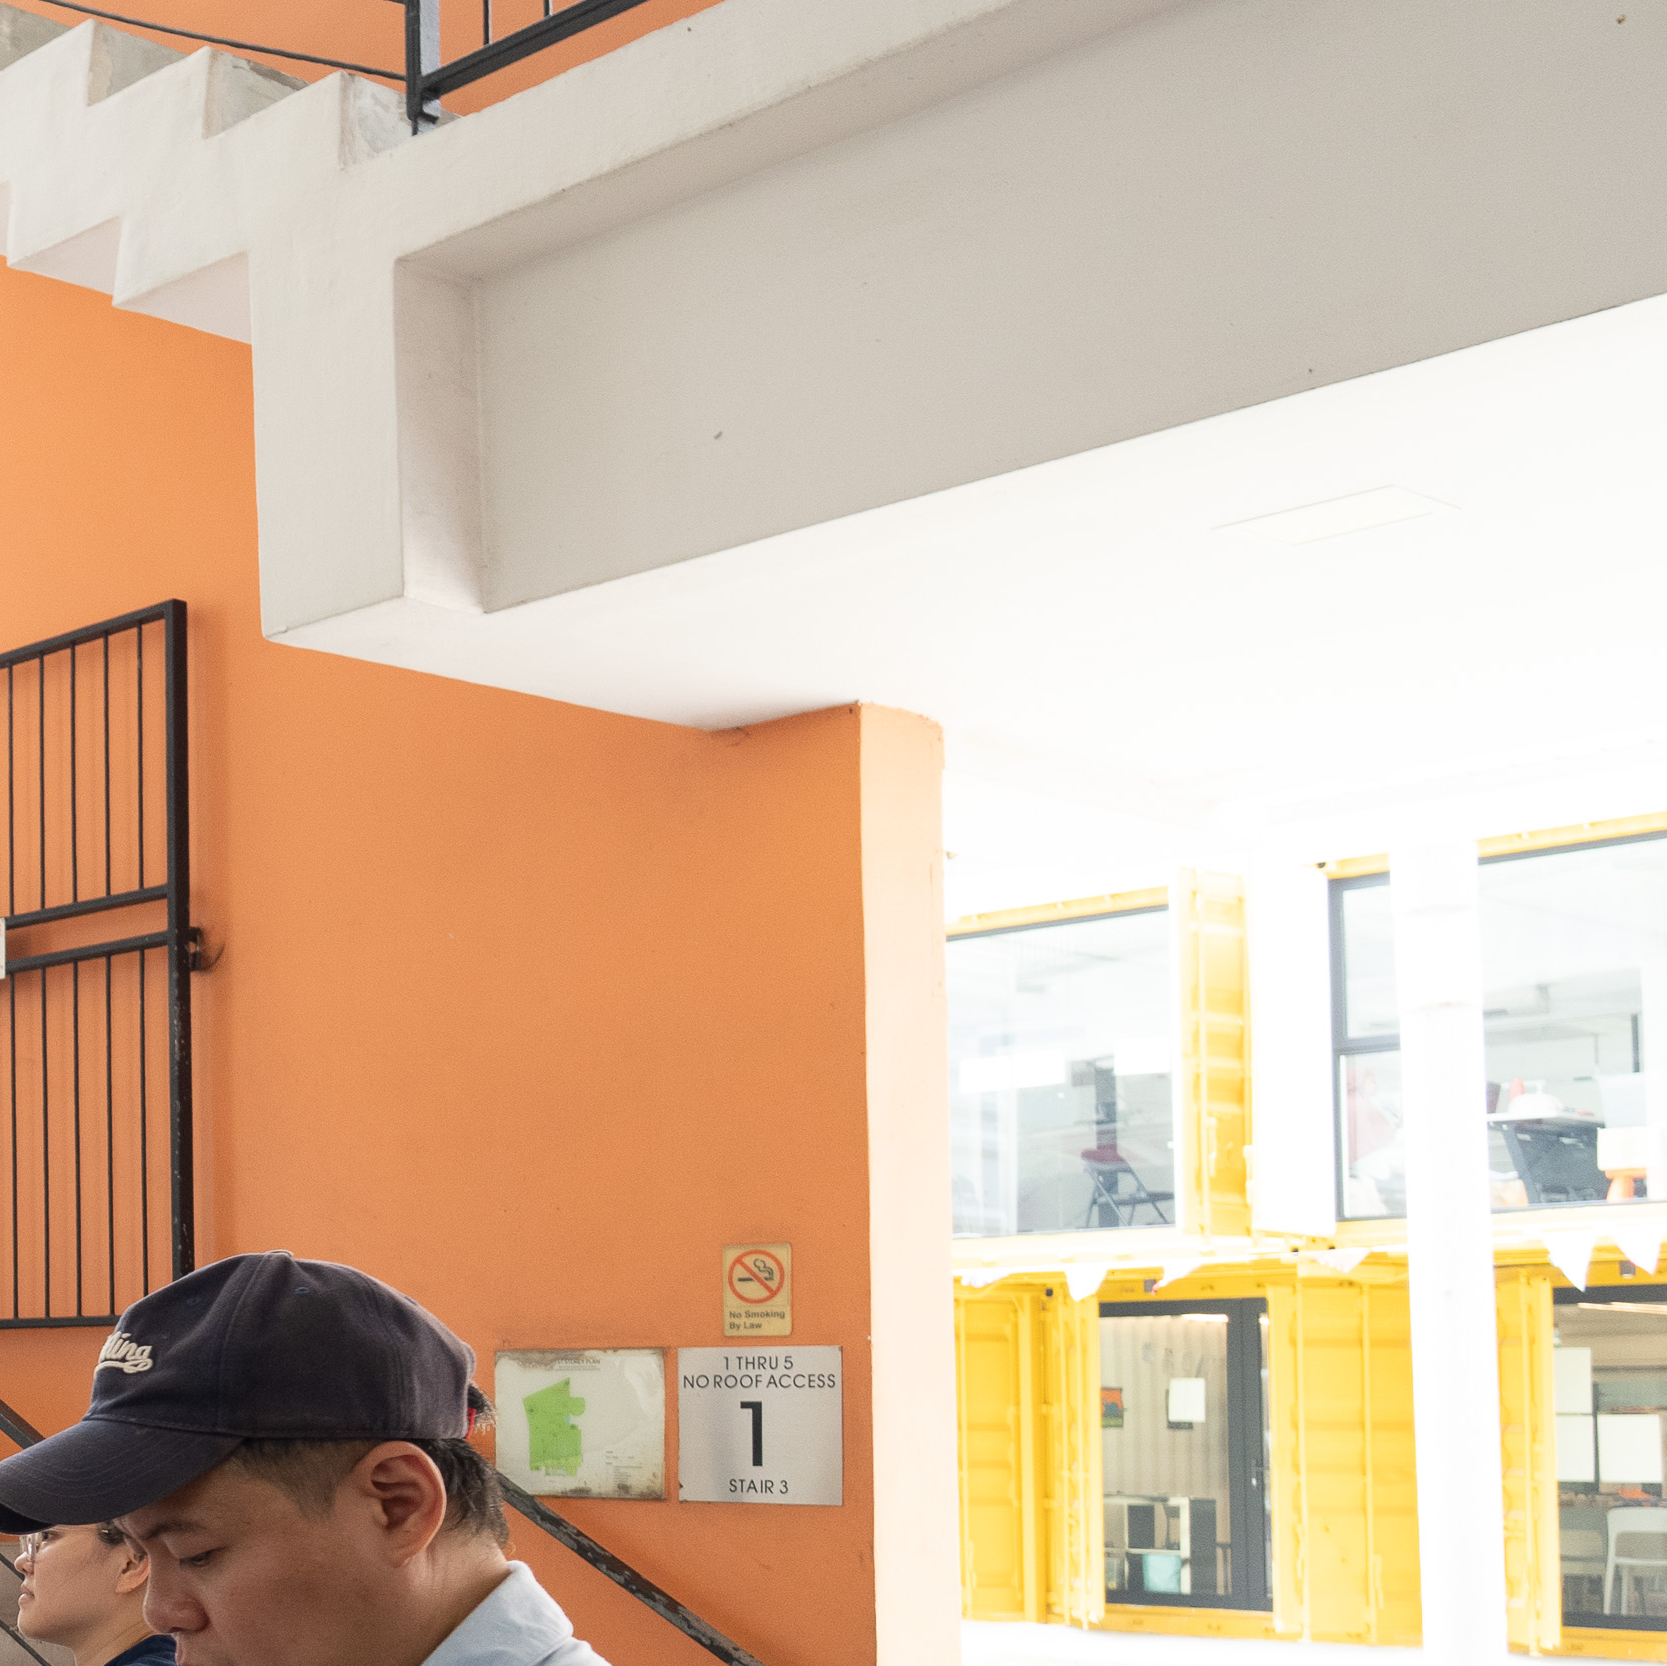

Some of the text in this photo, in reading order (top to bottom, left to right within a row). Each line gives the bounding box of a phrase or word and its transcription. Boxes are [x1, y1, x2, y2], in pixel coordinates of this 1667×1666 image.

[729, 1310, 785, 1319] No Smoking
[729, 1322, 741, 1331] By
[724, 1356, 794, 1370] 1 THRU 5
[683, 1374, 836, 1389] NO ROOF ACCESS
[740, 1401, 763, 1466] 1
[729, 1479, 789, 1494] STAIR 3
